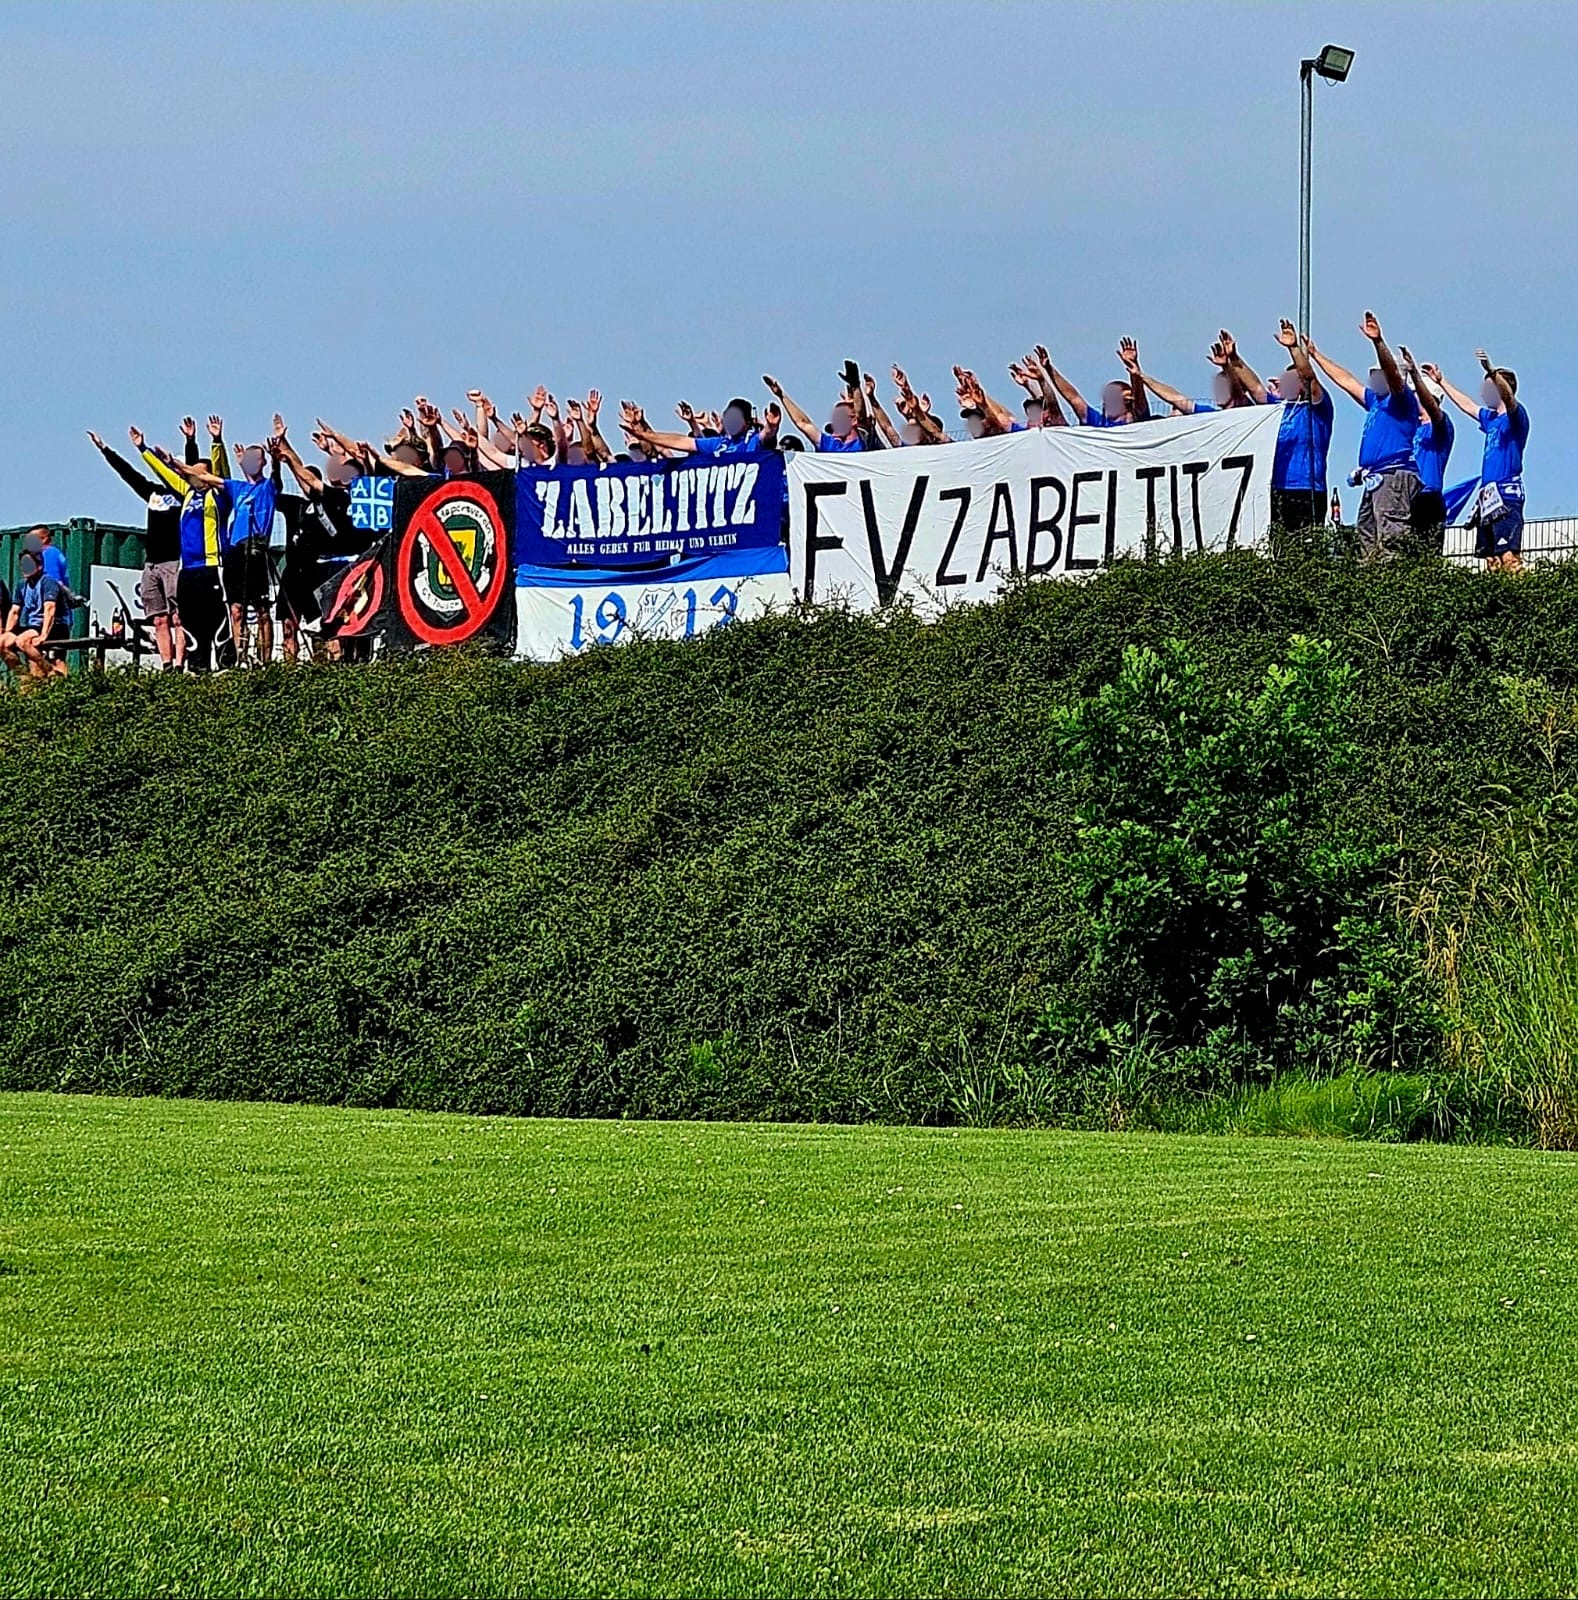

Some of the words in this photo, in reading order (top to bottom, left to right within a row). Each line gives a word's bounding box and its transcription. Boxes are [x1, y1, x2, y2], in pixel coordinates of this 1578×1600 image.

[535, 463, 760, 539] ZABELTITZ
[566, 543, 595, 555] ALLES
[599, 542, 629, 554] GEBEN
[689, 537, 705, 549] UND
[708, 533, 737, 547] VEREIN
[803, 474, 930, 607] FV
[935, 454, 1255, 587] ZABELTITZ
[643, 593, 659, 606] SV
